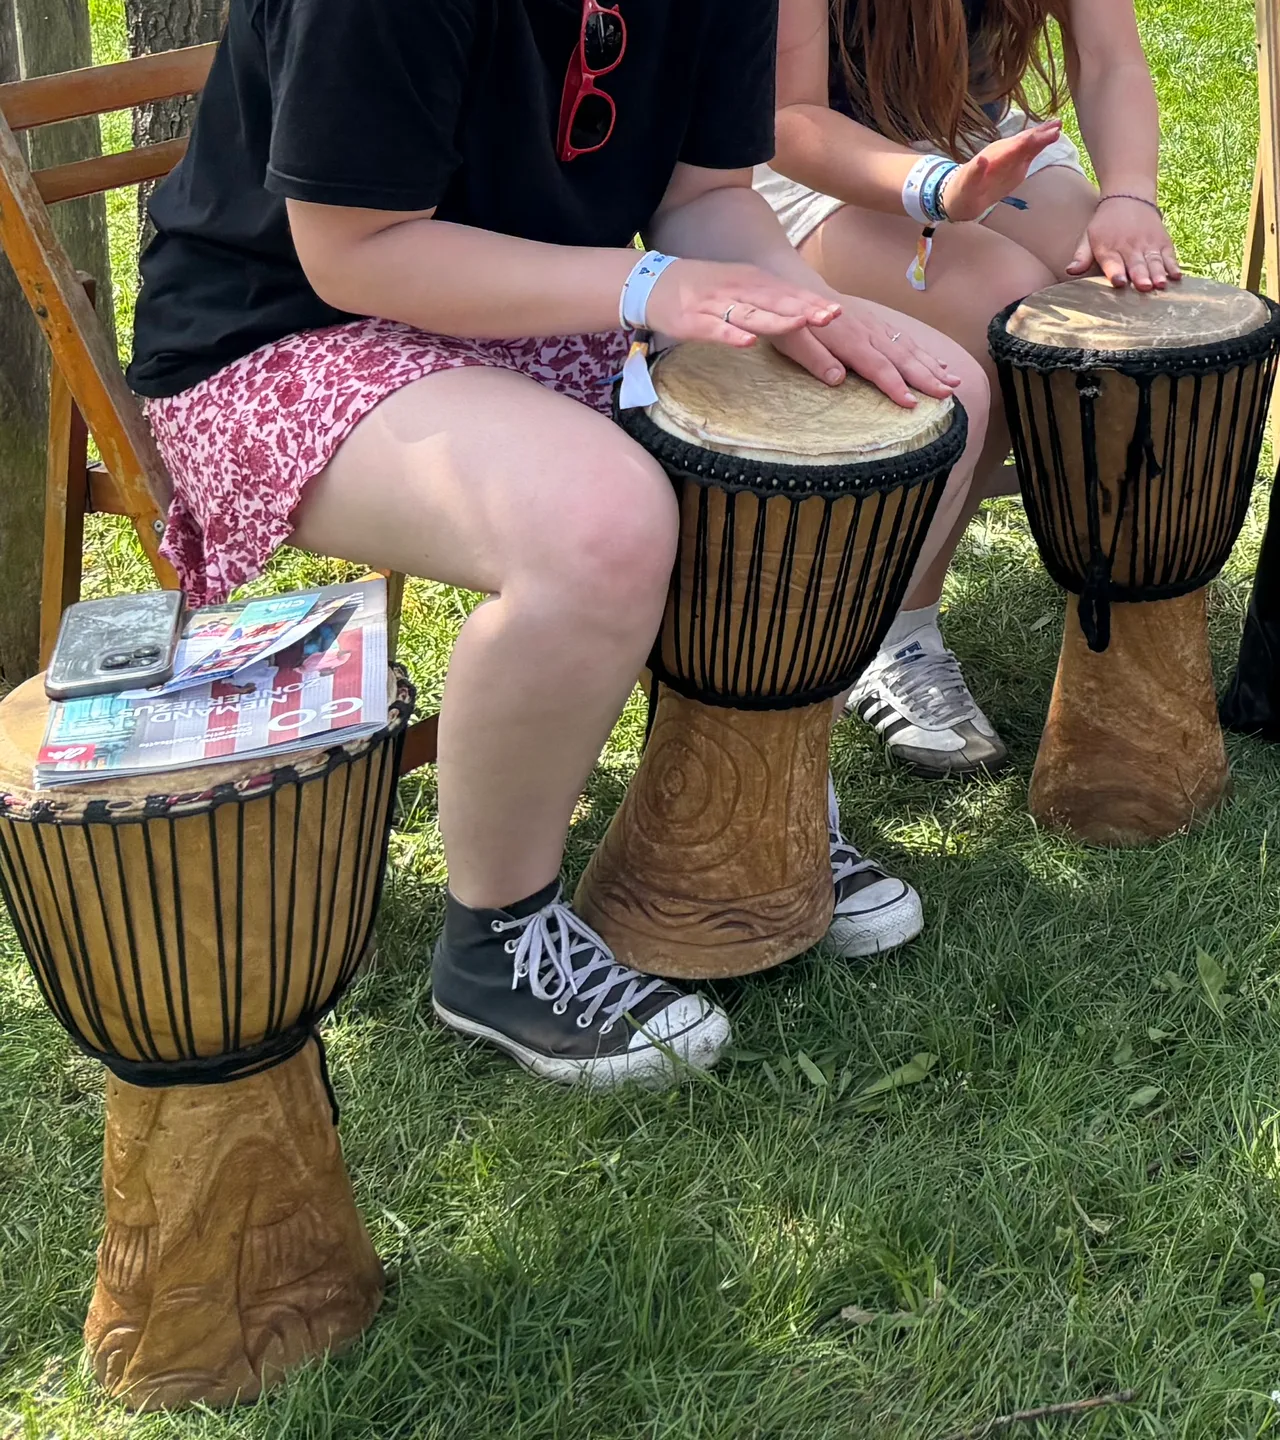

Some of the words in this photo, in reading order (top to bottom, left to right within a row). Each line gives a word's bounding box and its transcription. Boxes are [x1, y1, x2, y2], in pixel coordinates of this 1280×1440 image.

[211, 678, 321, 707] ZONDER
[118, 697, 200, 720] JEZUS
[150, 694, 288, 723] NIEMAND
[268, 697, 364, 732] GO
